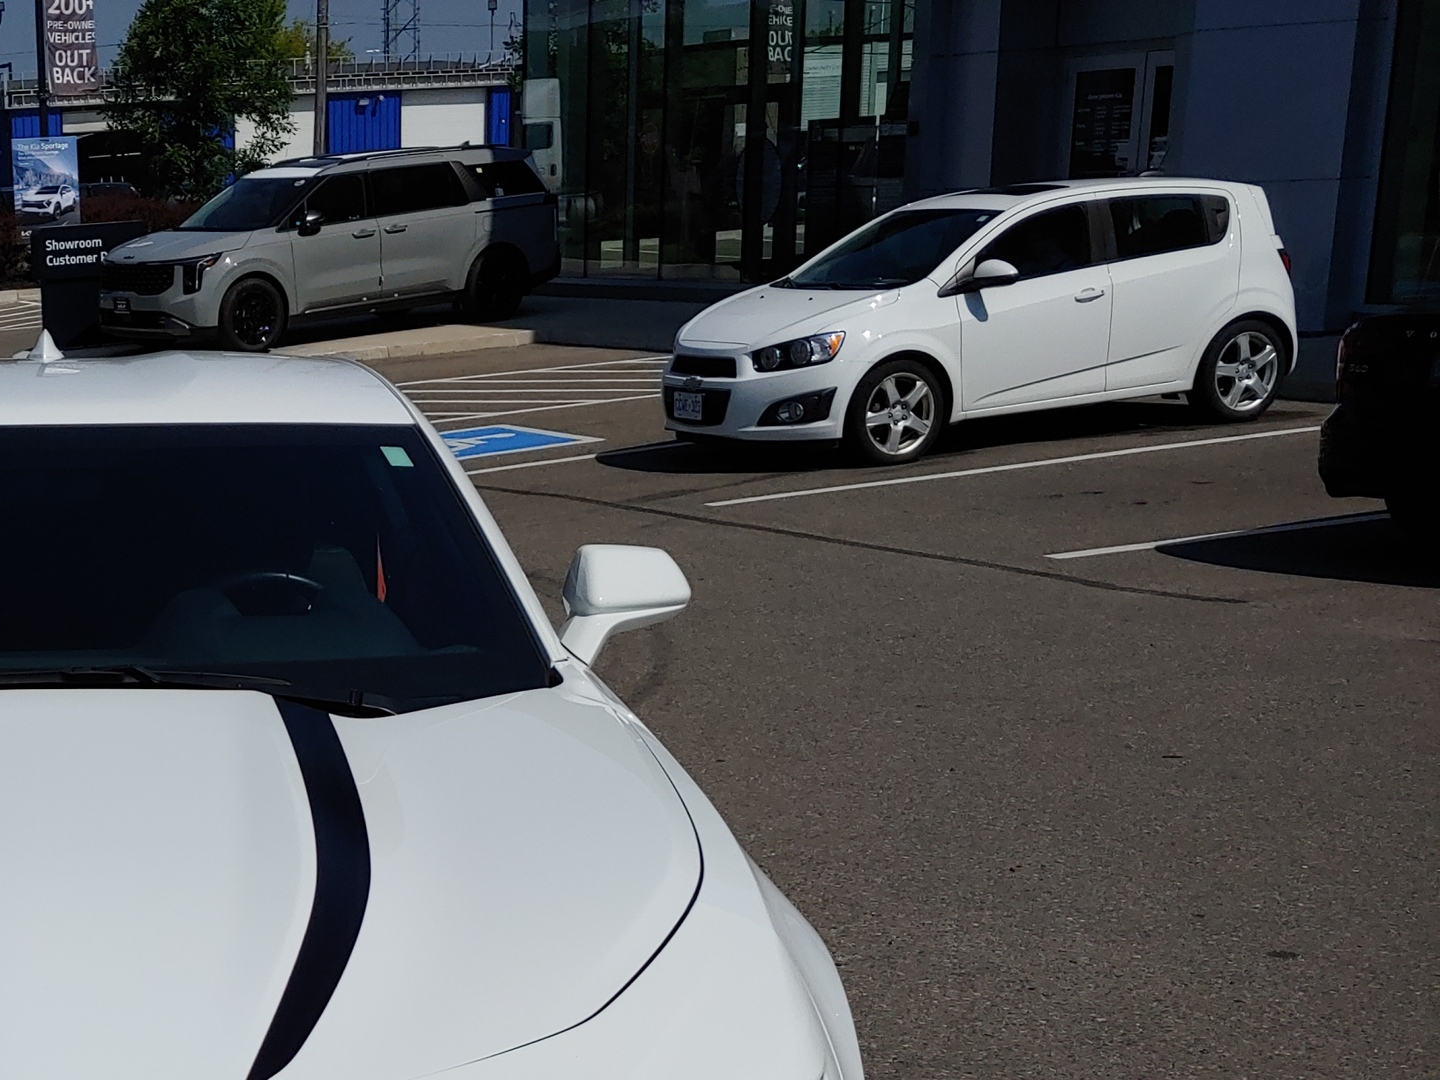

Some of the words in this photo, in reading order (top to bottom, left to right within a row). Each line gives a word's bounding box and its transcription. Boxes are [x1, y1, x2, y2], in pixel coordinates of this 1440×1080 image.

[47, 20, 95, 30] PRE-OWNE
[55, 49, 91, 66] OUT
[53, 66, 96, 84] BACK
[40, 142, 69, 151] Sportage
[45, 238, 102, 251] Showroom
[46, 254, 98, 266] Customer
